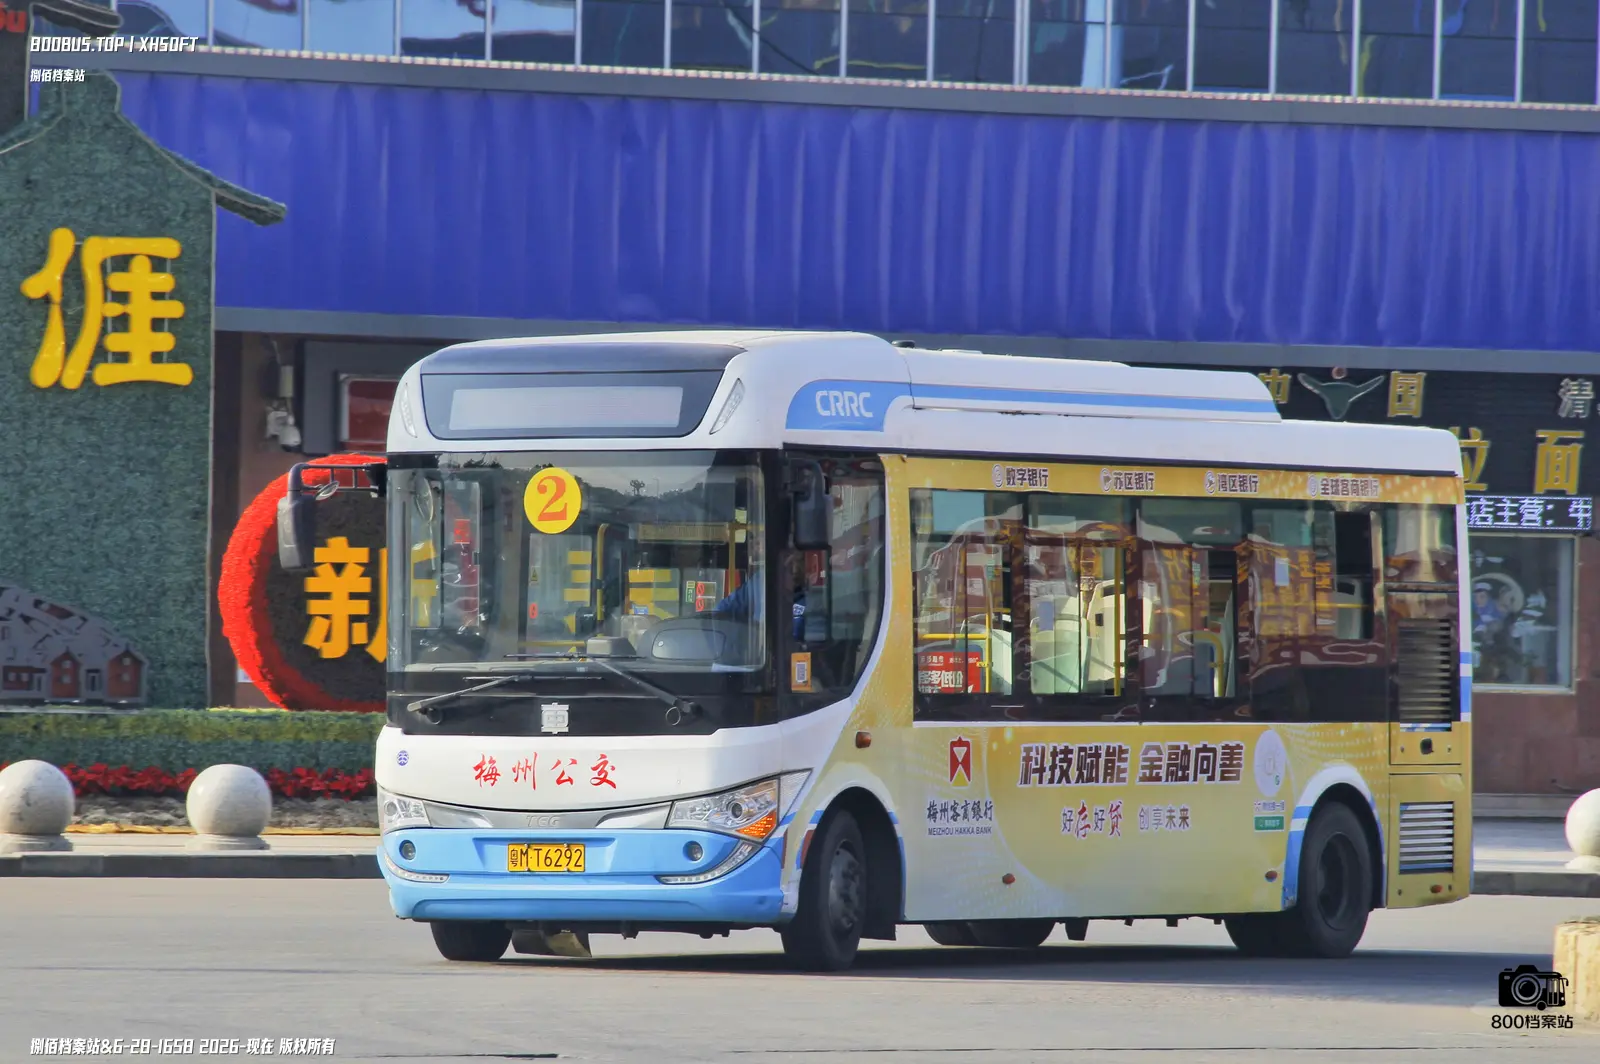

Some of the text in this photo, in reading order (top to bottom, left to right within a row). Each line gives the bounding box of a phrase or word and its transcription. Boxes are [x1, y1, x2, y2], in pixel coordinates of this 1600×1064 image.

[815, 390, 874, 418] CRRC
[1558, 378, 1600, 418] 清
[537, 475, 568, 521] 2
[1006, 467, 1379, 497] 数字银行 苏区银行 湾区银行 全球客商银行
[473, 752, 617, 790] 梅州公交
[1019, 742, 1244, 785] 科技赋能 金融向善
[928, 826, 992, 835] MEIZHOU HAKKA BANK
[1062, 801, 1189, 838] 好存好贷 创享未来
